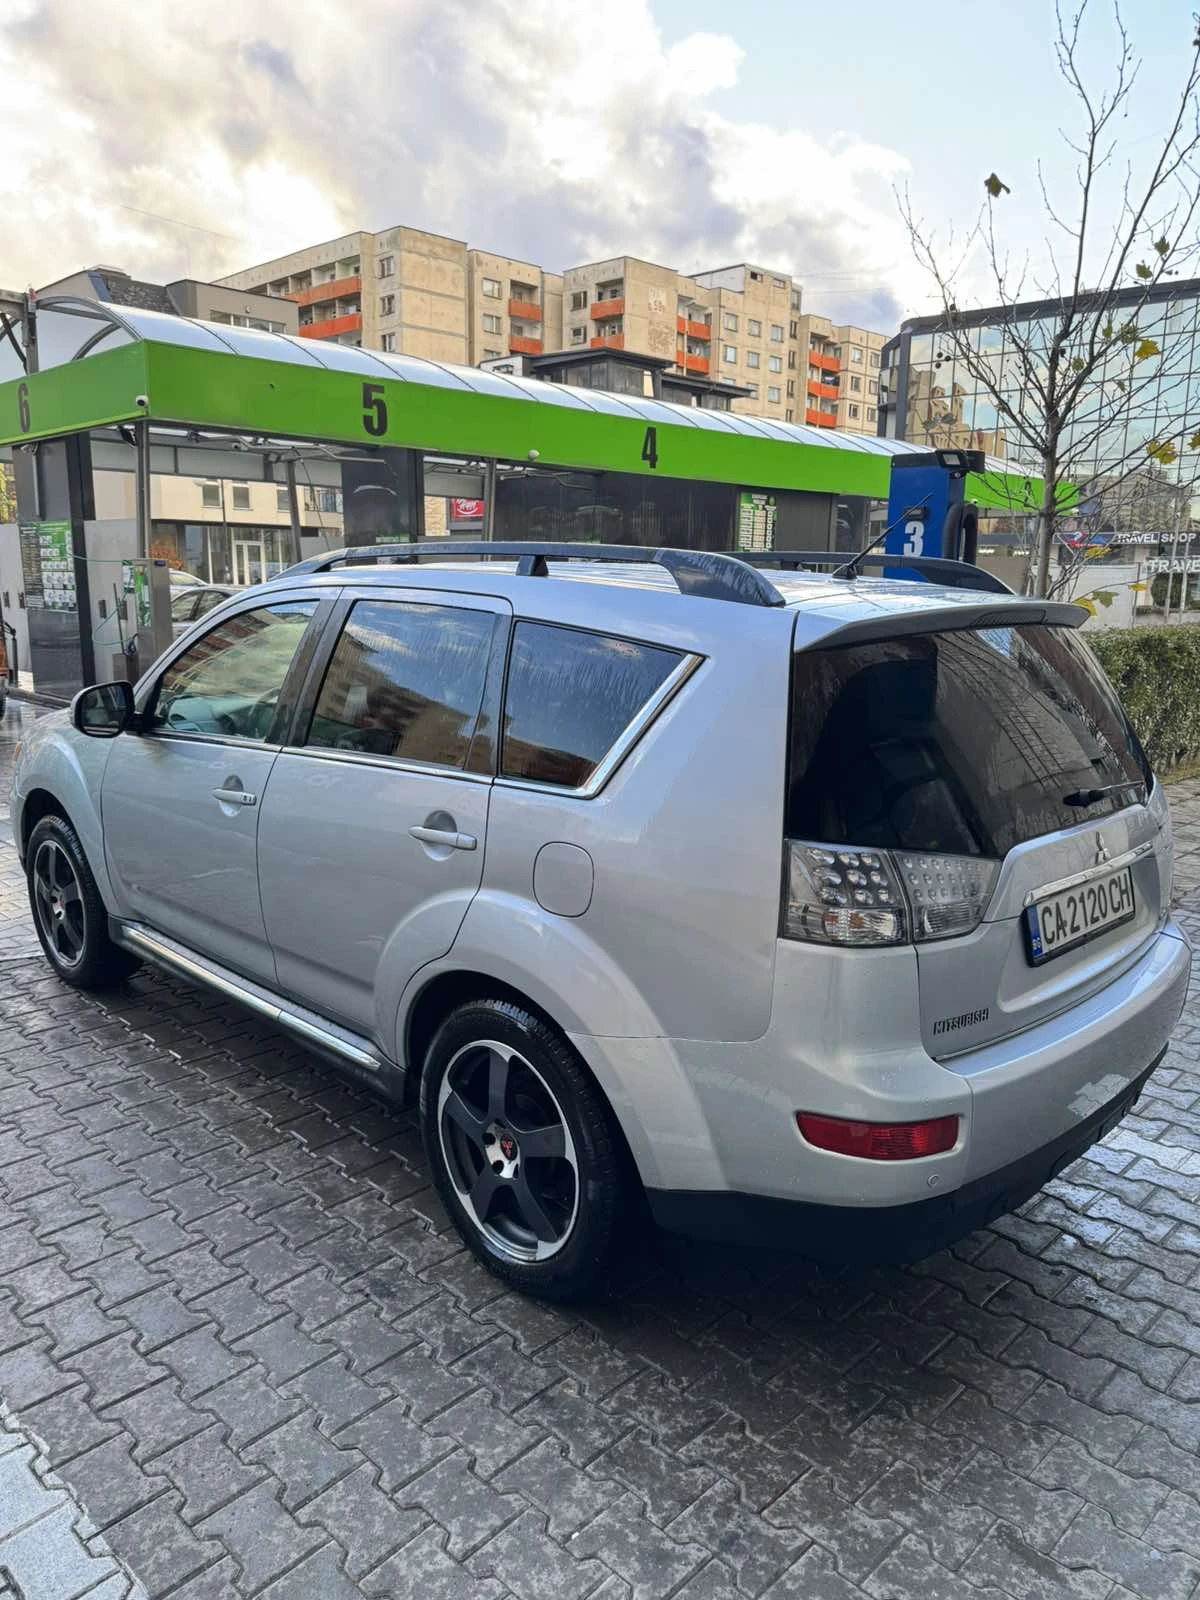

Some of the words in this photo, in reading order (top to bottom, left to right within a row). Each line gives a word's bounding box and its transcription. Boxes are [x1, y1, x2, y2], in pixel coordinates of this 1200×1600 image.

[17, 383, 31, 433] 6
[362, 382, 388, 437] 5
[641, 426, 658, 469] 4
[903, 521, 924, 558] 3
[1117, 532, 1158, 544] TRAVEL
[1161, 532, 1197, 543] SHOP
[933, 1007, 990, 1036] MITSUBISHI
